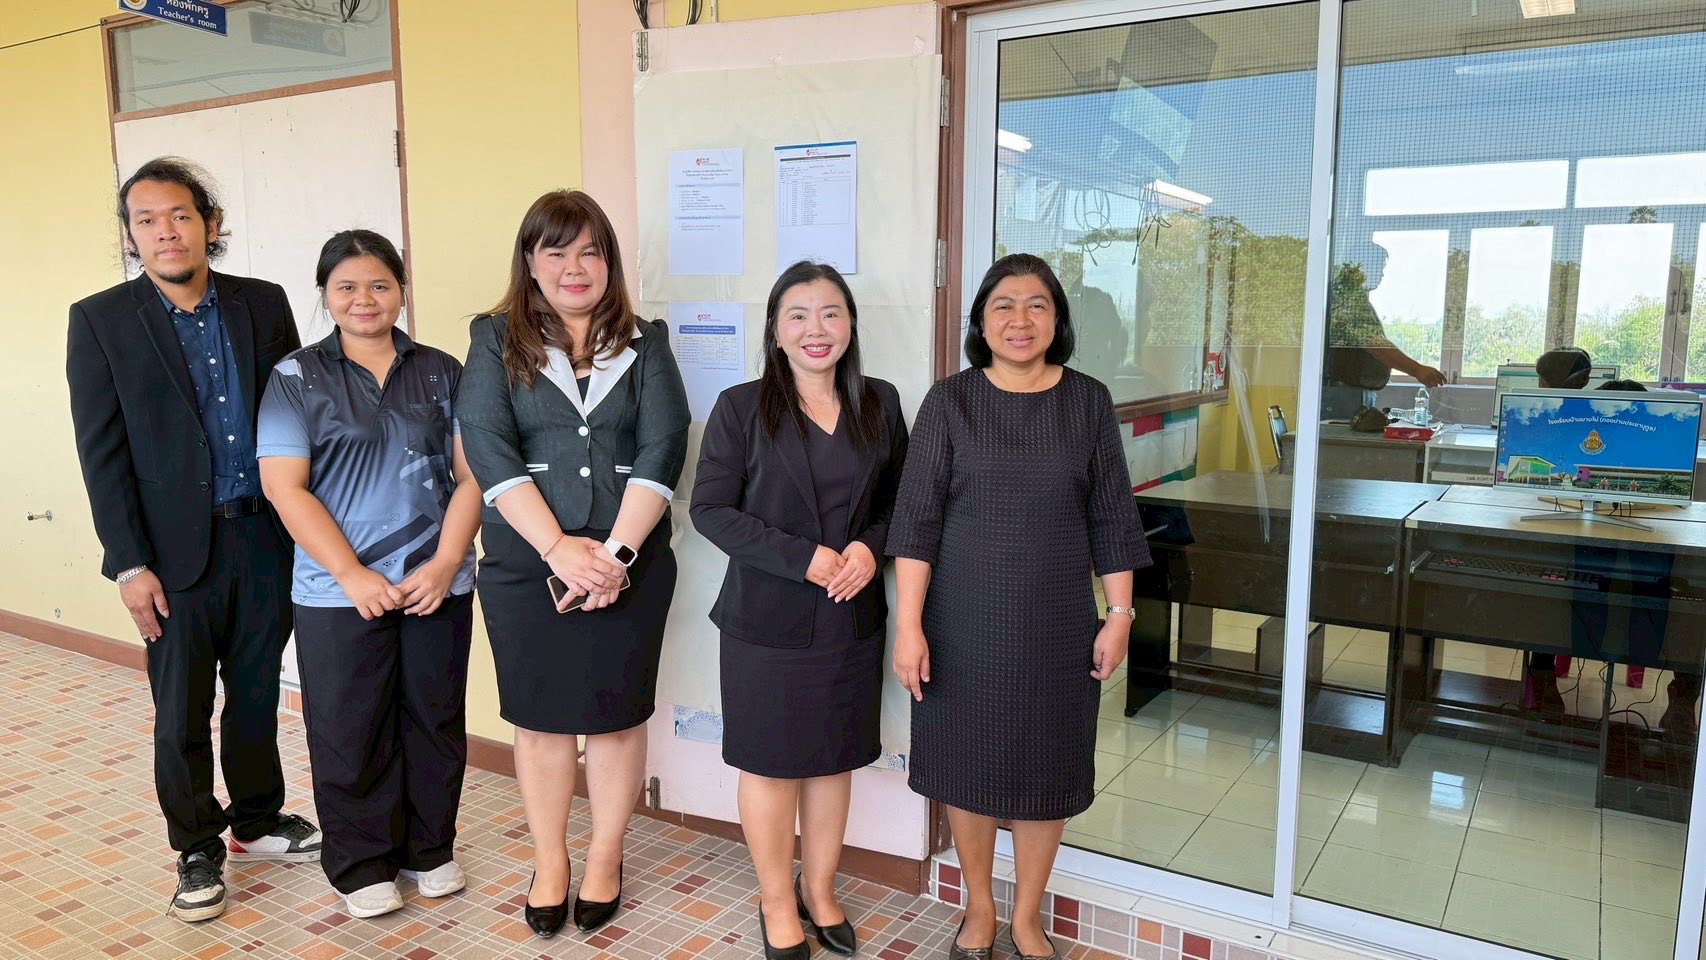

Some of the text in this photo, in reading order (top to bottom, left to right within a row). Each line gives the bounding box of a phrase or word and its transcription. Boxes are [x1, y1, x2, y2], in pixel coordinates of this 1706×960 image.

[157, 6, 217, 29] Teacher's room
[166, 0, 208, 19] หองพักครู
